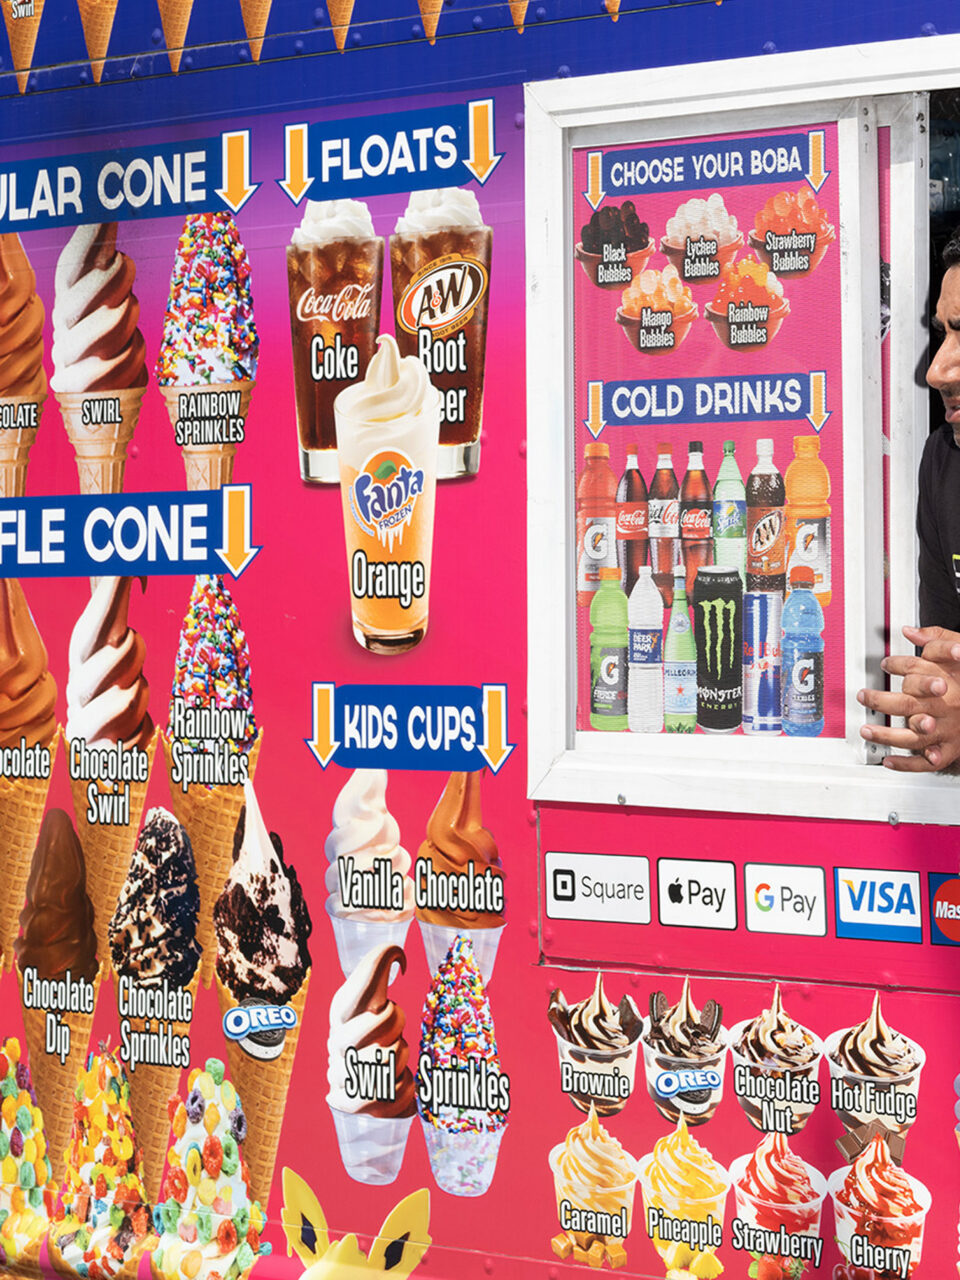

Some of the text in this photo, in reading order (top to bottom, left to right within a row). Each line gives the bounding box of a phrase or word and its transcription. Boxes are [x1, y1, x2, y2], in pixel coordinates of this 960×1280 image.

[12, 0, 35, 19] Swirl
[321, 125, 457, 183] FLOATS
[610, 147, 802, 187] CHOOSE YOUR BOBA
[97, 151, 206, 210] CONE
[603, 243, 626, 263] Black
[686, 237, 717, 257] Lychee
[766, 231, 816, 252] Strawberry
[598, 264, 632, 283] Bubbles
[684, 259, 719, 277] Bubbles
[773, 252, 809, 271] Bubbles
[296, 282, 375, 322] Coca-Cola
[416, 265, 469, 327] A&W
[728, 304, 768, 322] Rainbow
[640, 329, 674, 348] Bubbles
[642, 308, 672, 331] Mango
[730, 324, 767, 344] Bubbles
[311, 333, 359, 382] Coke
[418, 327, 467, 373] Root
[82, 399, 122, 424] SWIRL
[178, 391, 241, 418] RAINBOW
[612, 379, 802, 418] COLD DRINKS
[176, 418, 245, 445] SPRINKLES
[354, 467, 424, 523] Fanta
[84, 504, 208, 562] CONE
[378, 504, 412, 530] FROZEN
[352, 549, 424, 609] Orange
[174, 697, 247, 740] Rainbow
[344, 704, 477, 752] KIDS CUPS
[70, 737, 148, 781] Chocolate
[171, 741, 249, 792] Sprinkles
[87, 782, 130, 824] Swirl
[338, 856, 504, 913] Vanilla Chocolate
[581, 875, 645, 904] Square
[687, 879, 726, 913] Pay
[754, 883, 817, 921] G Pay
[841, 879, 916, 915] VISA
[23, 967, 94, 1013] Chocolate
[118, 974, 193, 1021] Chocolate
[46, 1013, 71, 1063] Dip
[225, 1006, 296, 1038] OREO
[120, 1020, 190, 1071] Sprinkles
[345, 1047, 395, 1101] Swirl
[418, 1052, 510, 1115] Sprinkles
[561, 1063, 630, 1099] Brownie
[657, 1070, 721, 1098] OREO
[733, 1065, 820, 1104] Chocolate
[762, 1101, 793, 1132] Nut
[832, 1079, 917, 1123] Hot Fudge
[560, 1201, 627, 1238] Caramel
[648, 1208, 722, 1252] Pineapple
[732, 1219, 823, 1267] Strawberry
[850, 1235, 911, 1276] Cherry
